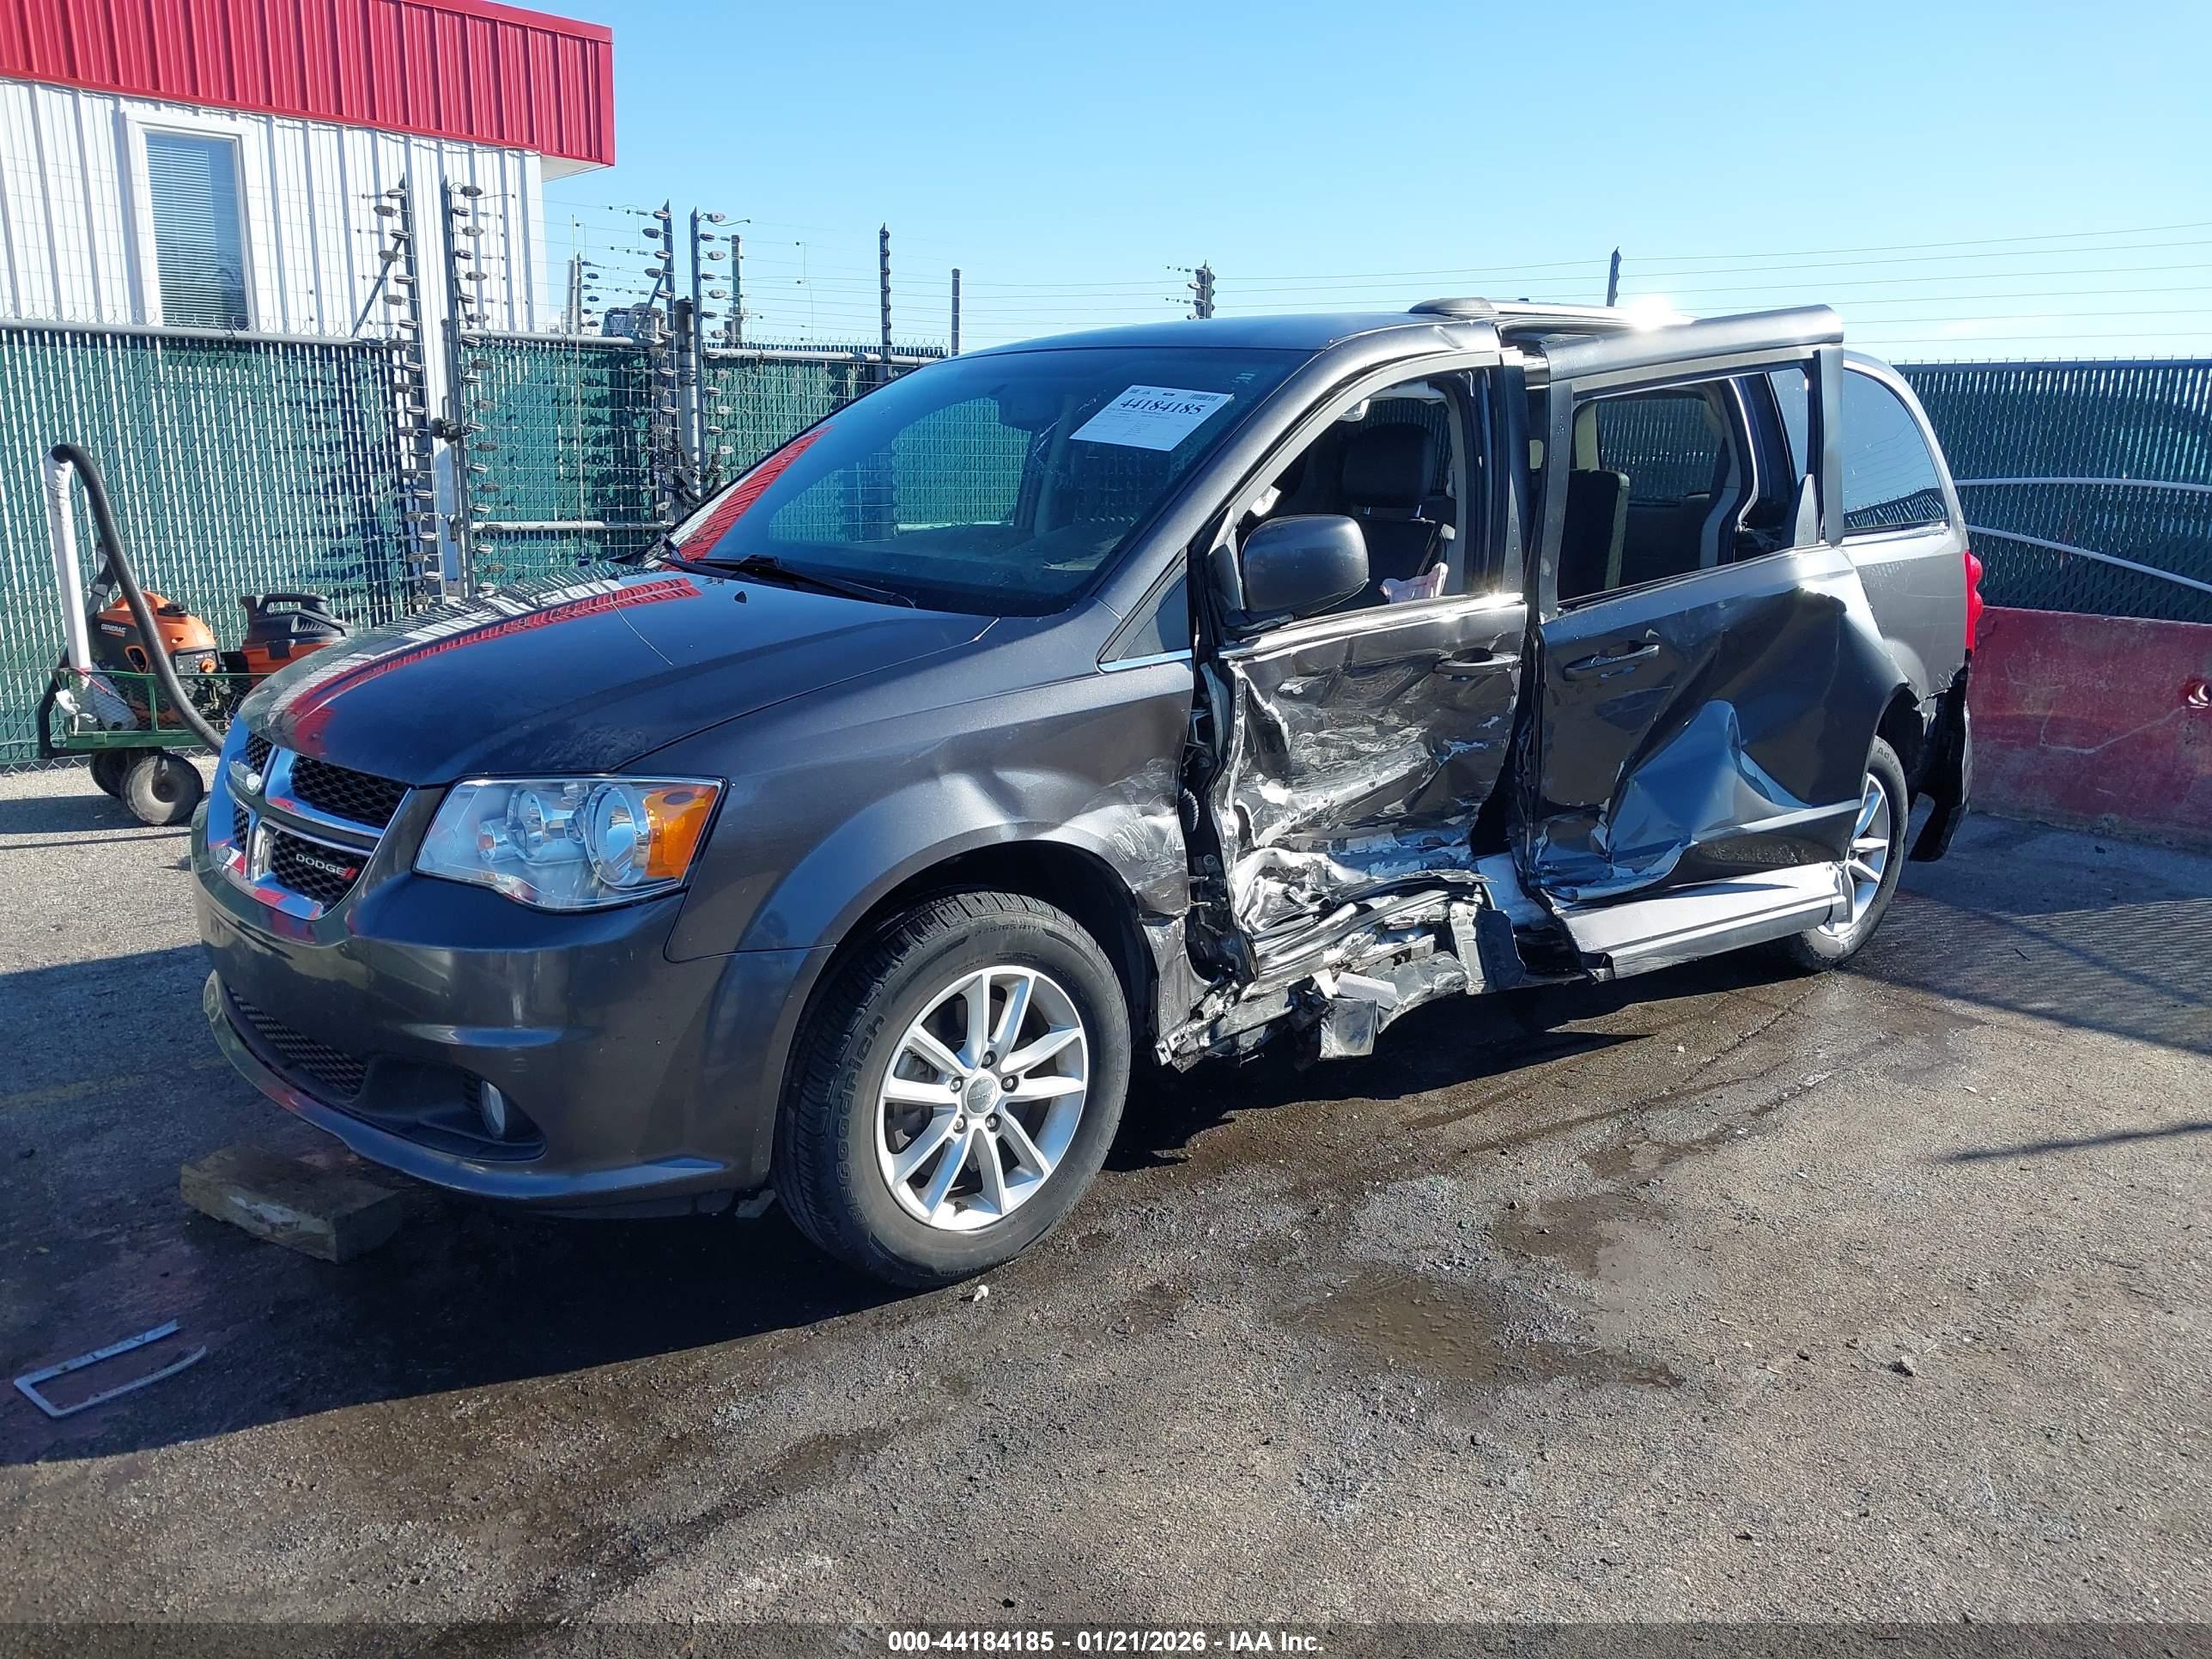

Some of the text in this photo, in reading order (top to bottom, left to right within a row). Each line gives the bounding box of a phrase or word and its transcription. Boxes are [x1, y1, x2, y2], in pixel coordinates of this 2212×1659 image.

[1120, 398, 1207, 415] 44184185
[296, 854, 348, 877] DODGE
[836, 1014, 885, 1225] BFGoodrich
